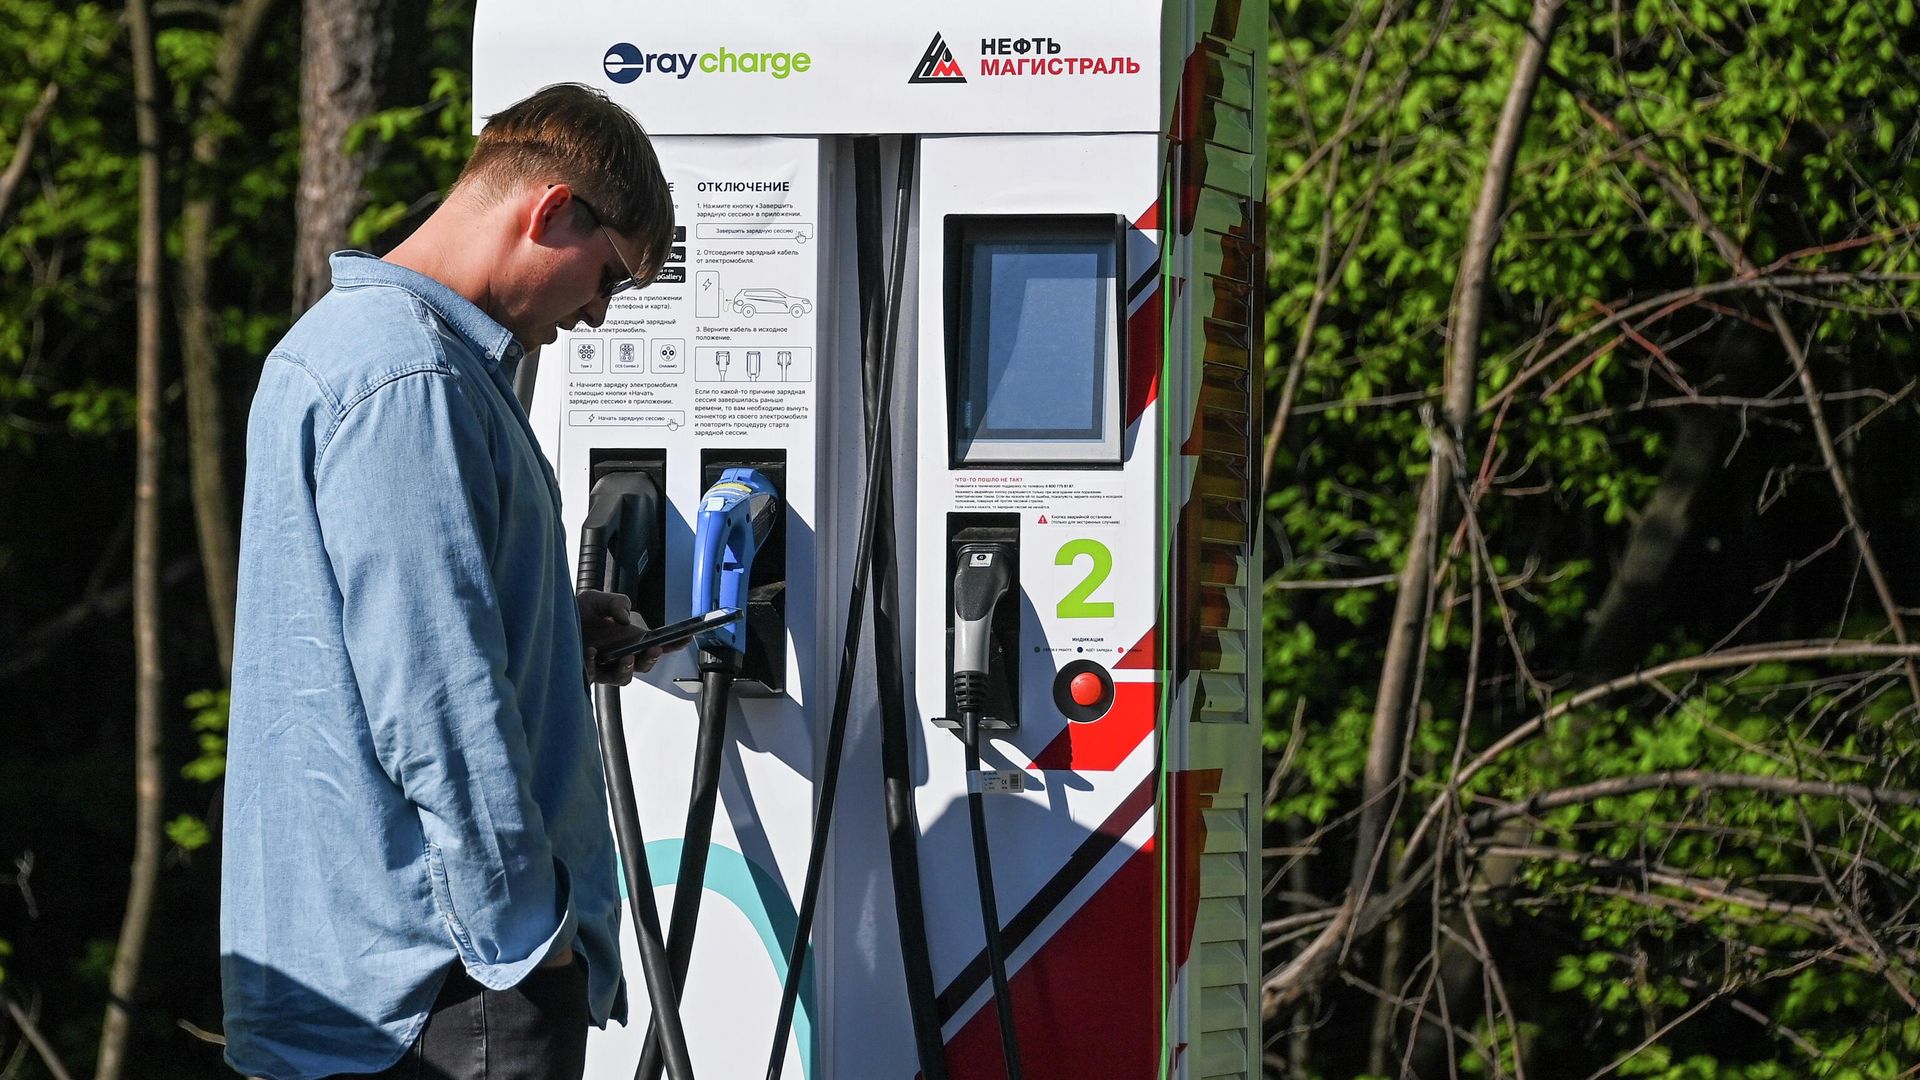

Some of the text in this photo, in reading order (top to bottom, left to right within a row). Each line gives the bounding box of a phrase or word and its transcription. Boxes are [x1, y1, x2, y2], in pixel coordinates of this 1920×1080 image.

[981, 38, 1061, 55] НЕФТЬ
[980, 58, 1140, 76] МАГИСТРАЛЬ
[697, 181, 790, 192] ОТКЛЮЧЕНИЕ
[670, 252, 682, 260] Play
[1055, 538, 1114, 618] 2
